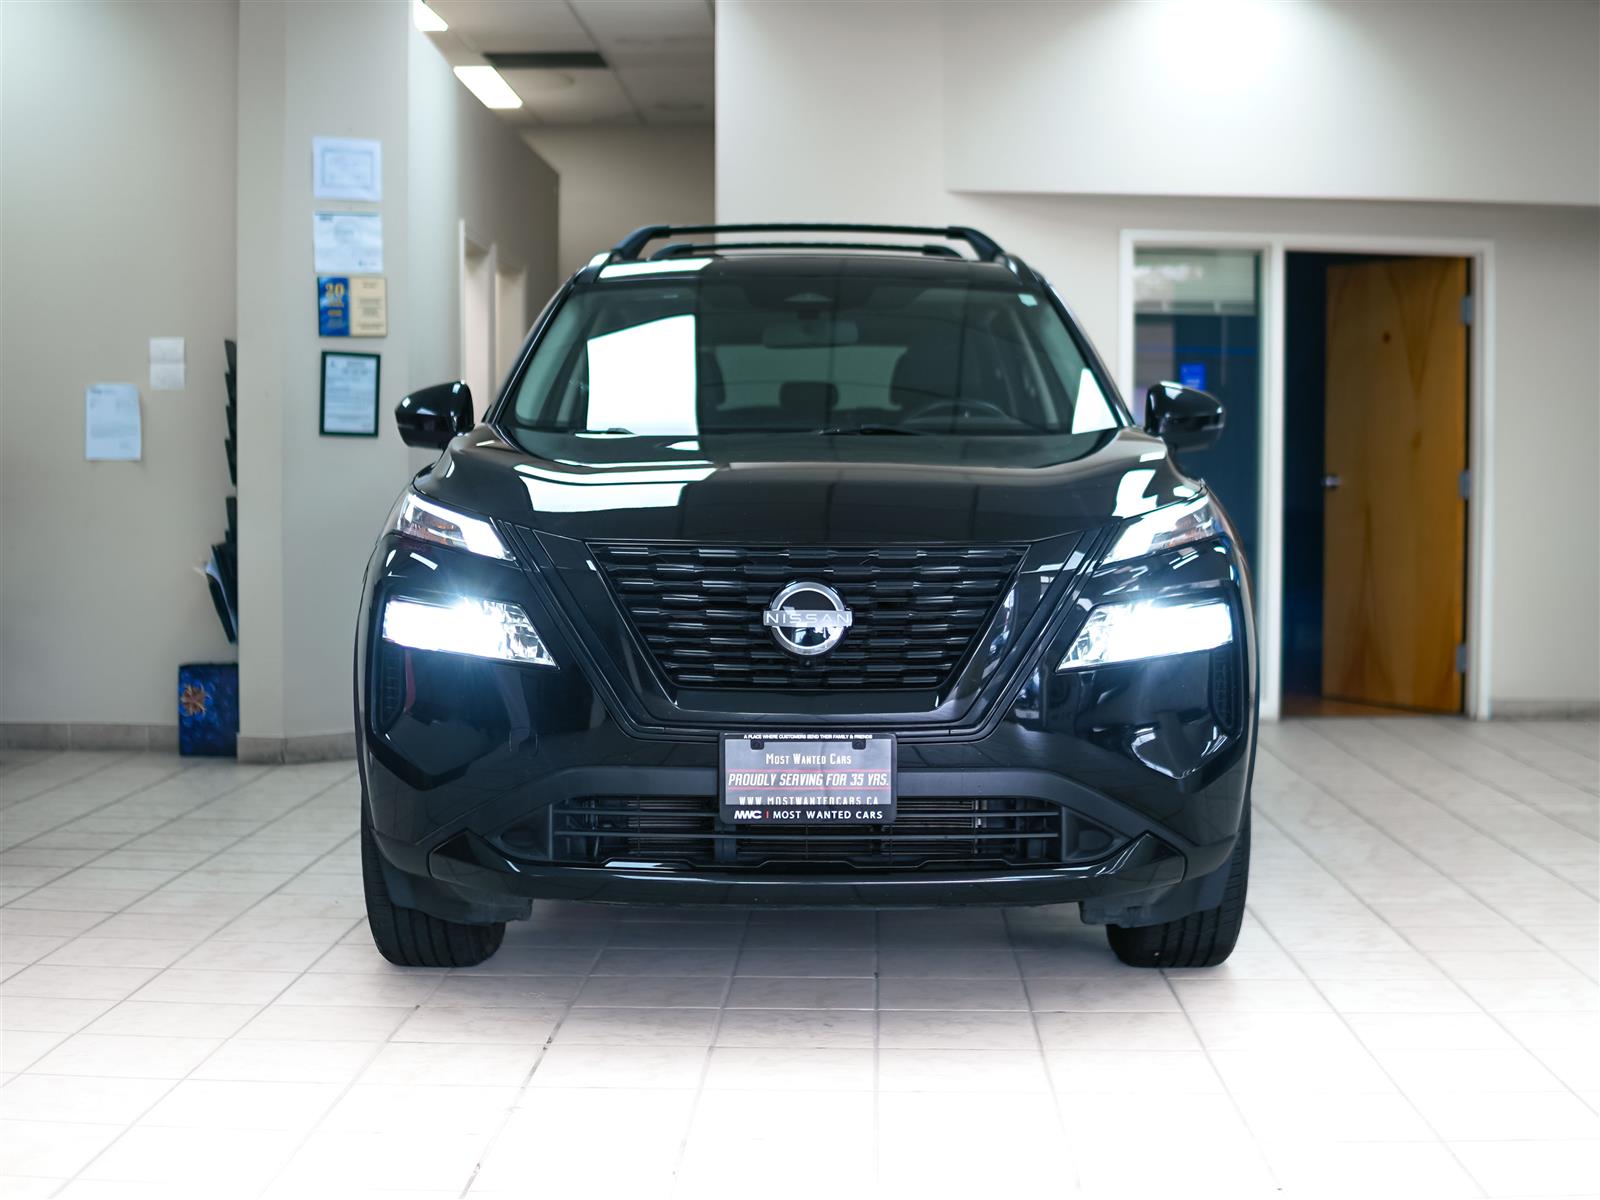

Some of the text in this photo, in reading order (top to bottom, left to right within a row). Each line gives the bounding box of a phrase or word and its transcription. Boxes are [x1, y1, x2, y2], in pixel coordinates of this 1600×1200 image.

[766, 612, 850, 624] NISSAN
[728, 773, 889, 786] PROUDLY SERVING FOR 35 YRS.
[738, 796, 879, 805] WWWMOSTWANTEDCARSCA
[773, 810, 801, 819] MOST
[806, 810, 852, 819] WANTED
[855, 810, 883, 819] CARS
